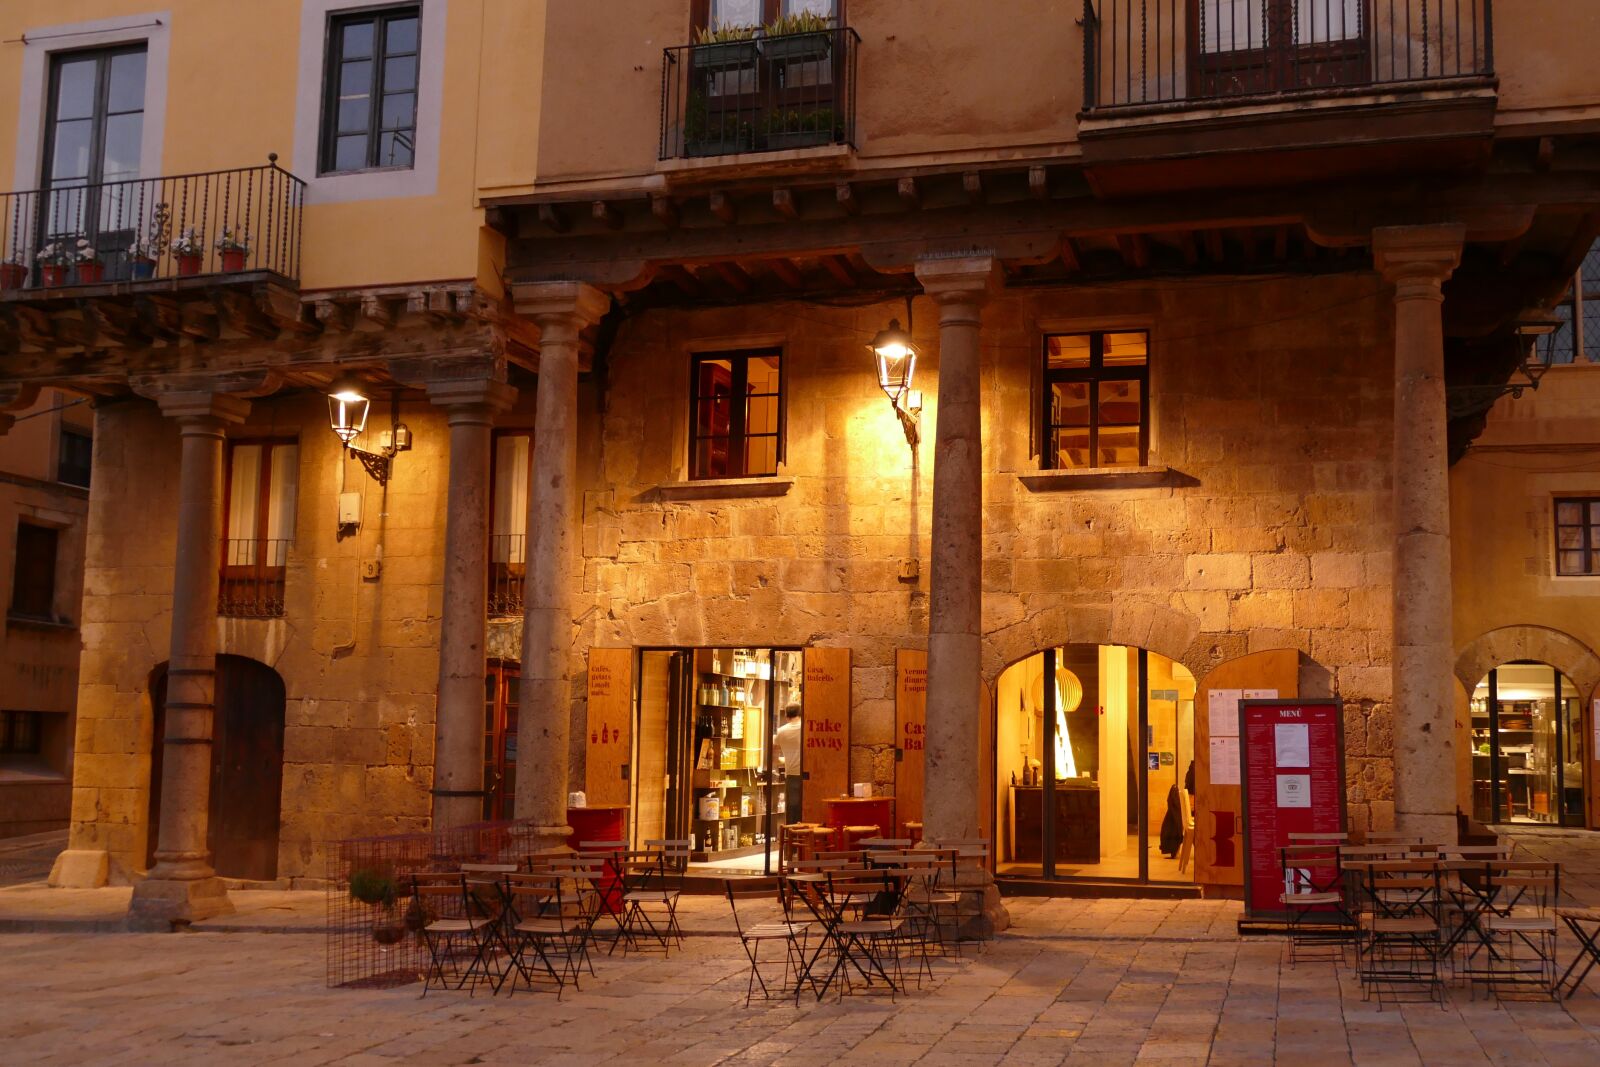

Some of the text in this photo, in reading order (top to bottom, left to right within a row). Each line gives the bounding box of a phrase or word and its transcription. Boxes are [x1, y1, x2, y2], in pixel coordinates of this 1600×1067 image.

[368, 564, 373, 575] 9
[1279, 707, 1302, 718] MENÚ
[807, 718, 842, 732] Take
[904, 721, 926, 734] Cas
[807, 737, 842, 751] away
